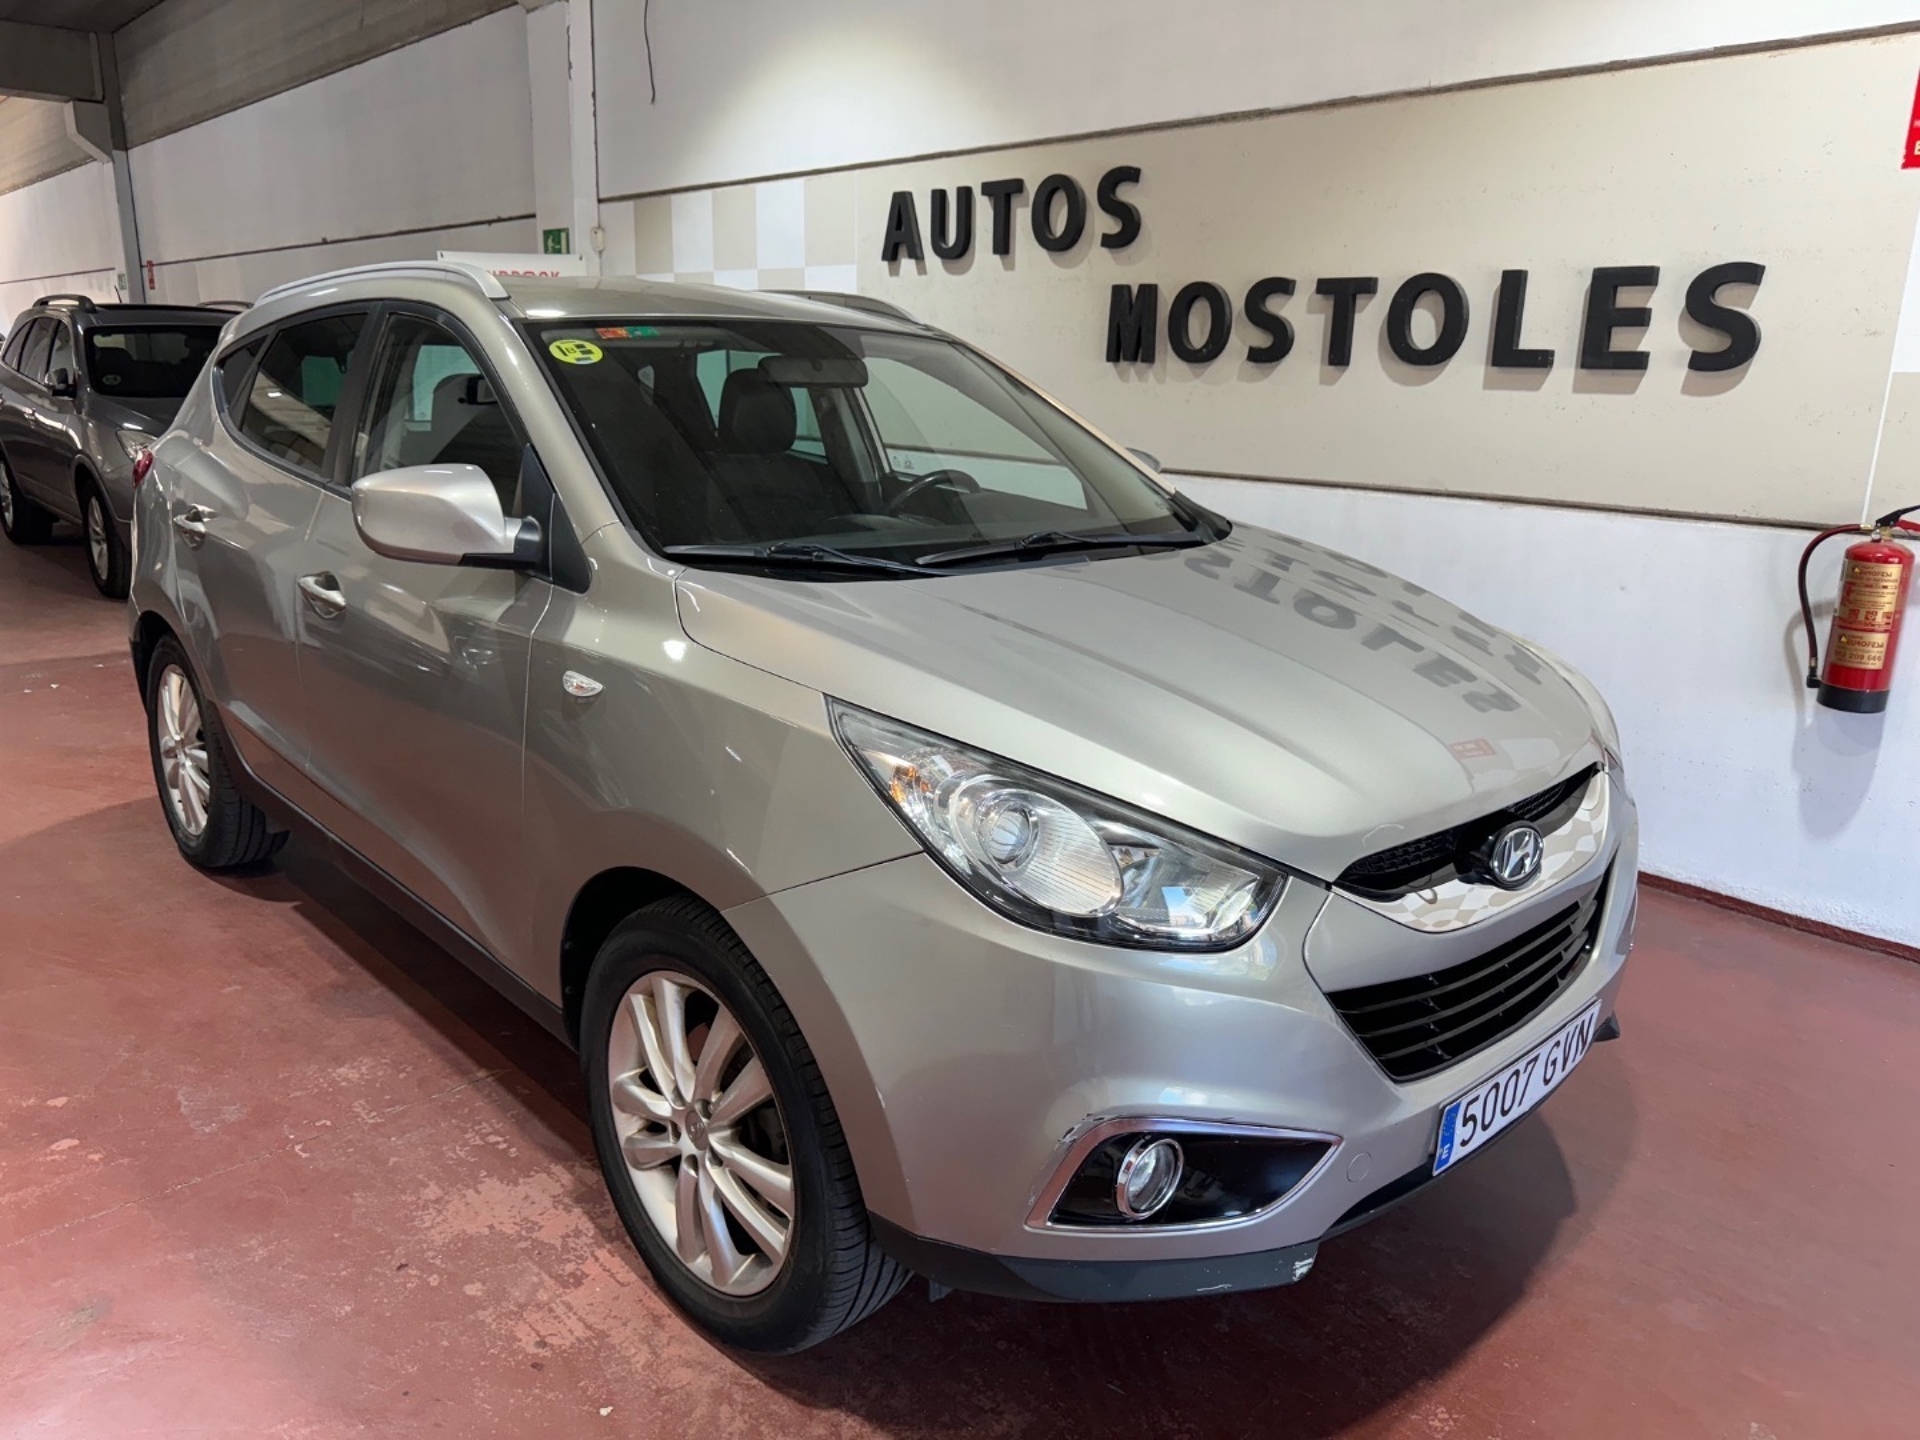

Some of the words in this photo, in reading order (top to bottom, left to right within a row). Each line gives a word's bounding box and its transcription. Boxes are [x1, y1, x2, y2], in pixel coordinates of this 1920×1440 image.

[881, 165, 1142, 262] AUTOS
[1106, 261, 1766, 372] MOSTOLES
[1460, 1053, 1541, 1147] 5007
[1543, 1013, 1595, 1087] GVN
